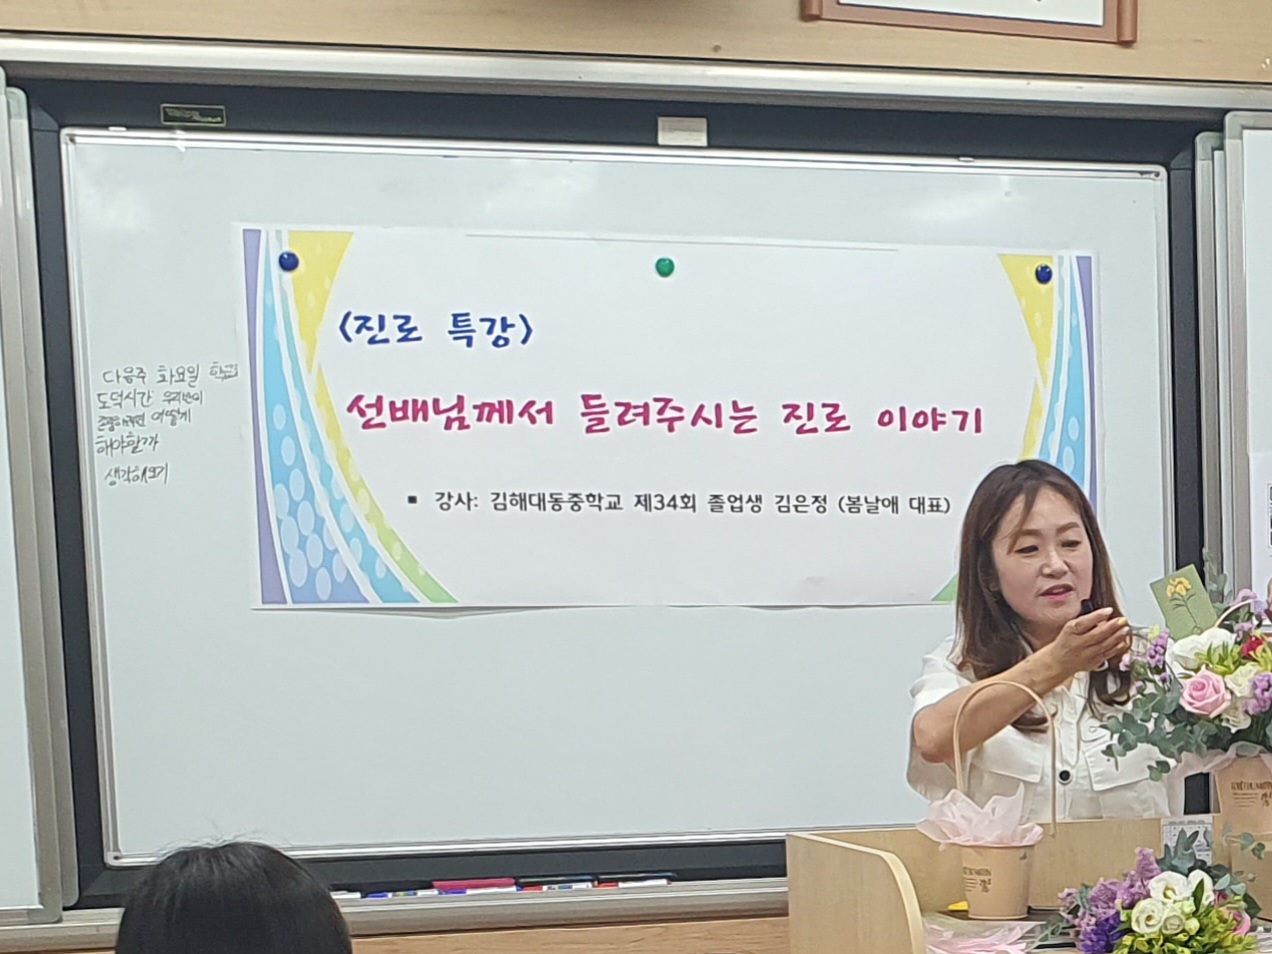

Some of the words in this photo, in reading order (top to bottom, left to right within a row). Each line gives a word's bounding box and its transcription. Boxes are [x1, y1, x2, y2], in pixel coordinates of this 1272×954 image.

[102, 366, 147, 385] 다음주
[156, 363, 200, 388] 화요일
[96, 388, 153, 410] 도덕시간
[151, 408, 192, 427] 어떻게
[345, 393, 554, 431] 선배님께서
[580, 393, 758, 435] 들려주시는
[781, 401, 852, 436] 진로
[876, 405, 983, 434] 이야기
[95, 431, 159, 458] 해야할까
[434, 490, 479, 512] 강사:
[490, 491, 624, 513] 김해대동중학교
[633, 492, 697, 514] 제34회
[706, 493, 763, 514] 졸업생
[774, 493, 828, 515] 김은정
[837, 494, 900, 516] (봄날애
[908, 495, 951, 516] 대표)
